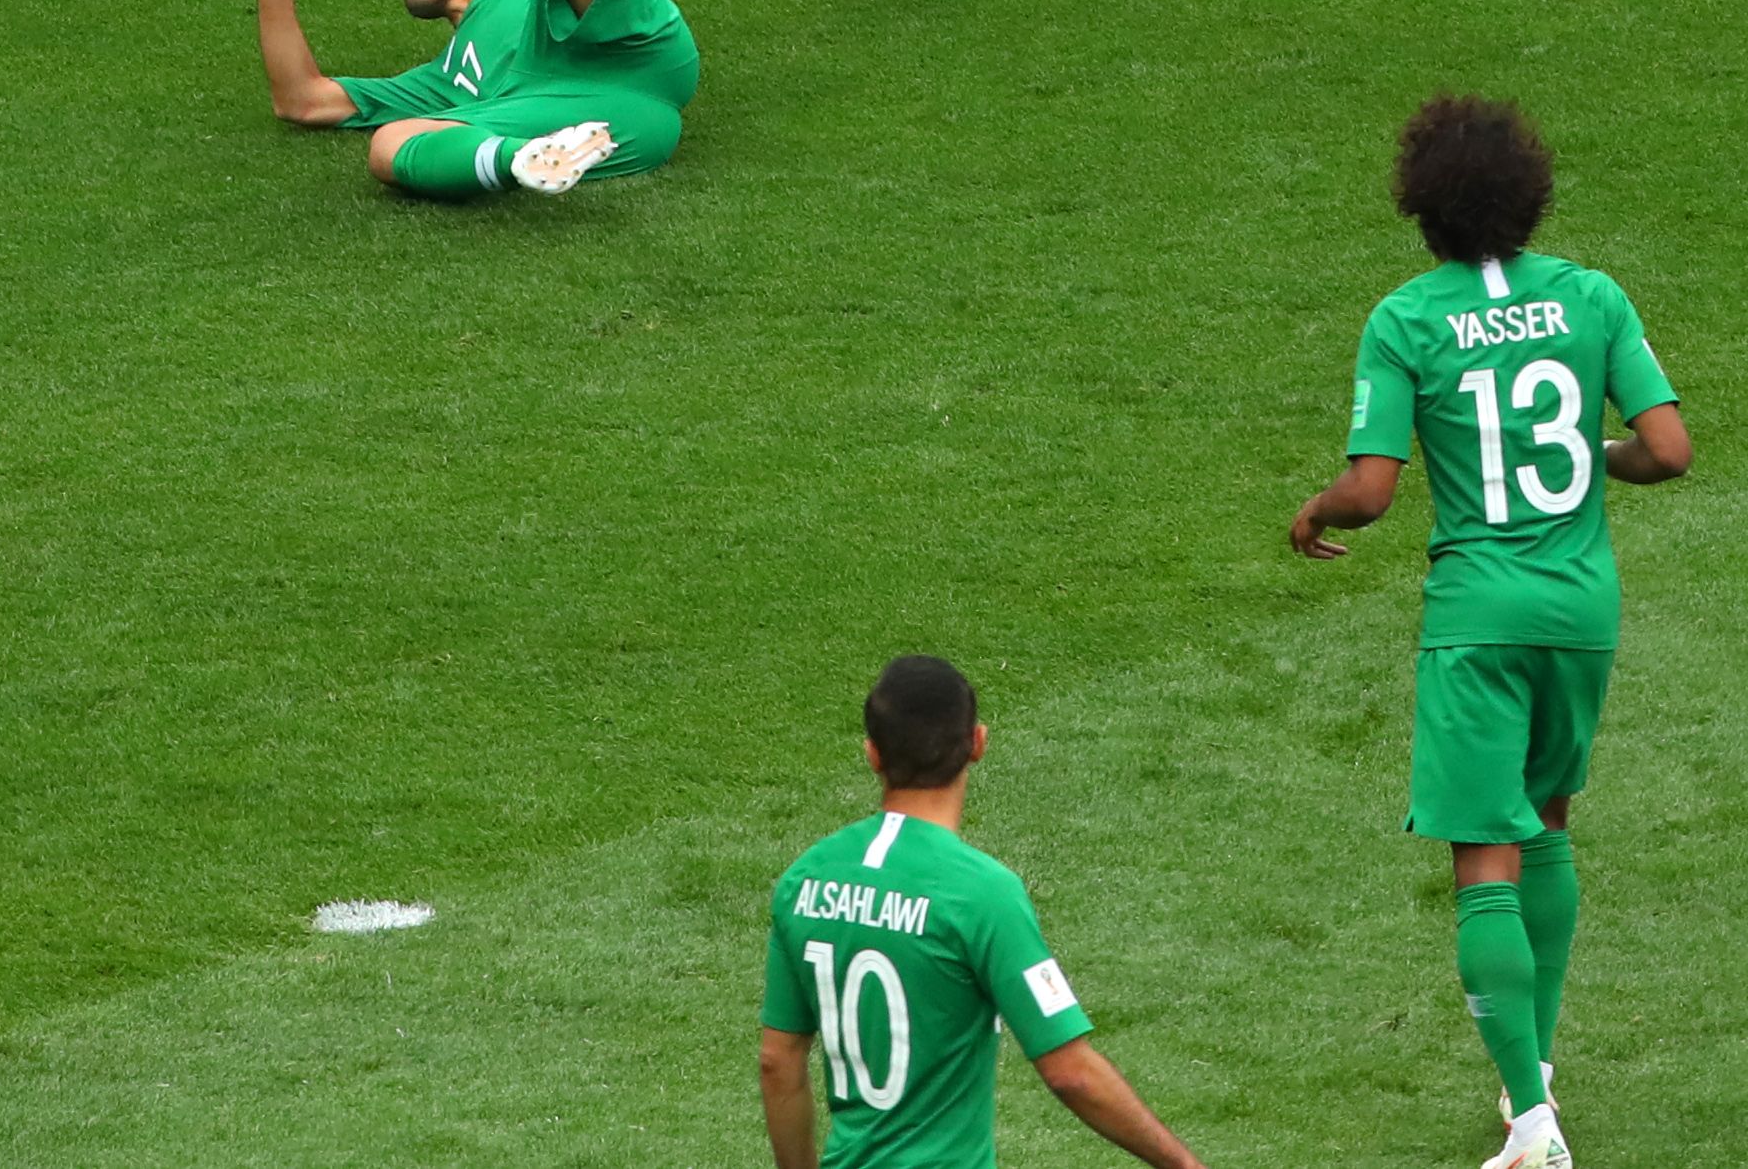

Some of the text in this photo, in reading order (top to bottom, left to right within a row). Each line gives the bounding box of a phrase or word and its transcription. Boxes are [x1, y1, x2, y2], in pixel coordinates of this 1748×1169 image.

[453, 40, 483, 97] 17
[1446, 300, 1571, 350] YASSER
[1458, 359, 1592, 524] 13
[794, 879, 930, 936] ALSAHLAWI
[804, 940, 911, 1111] 10
